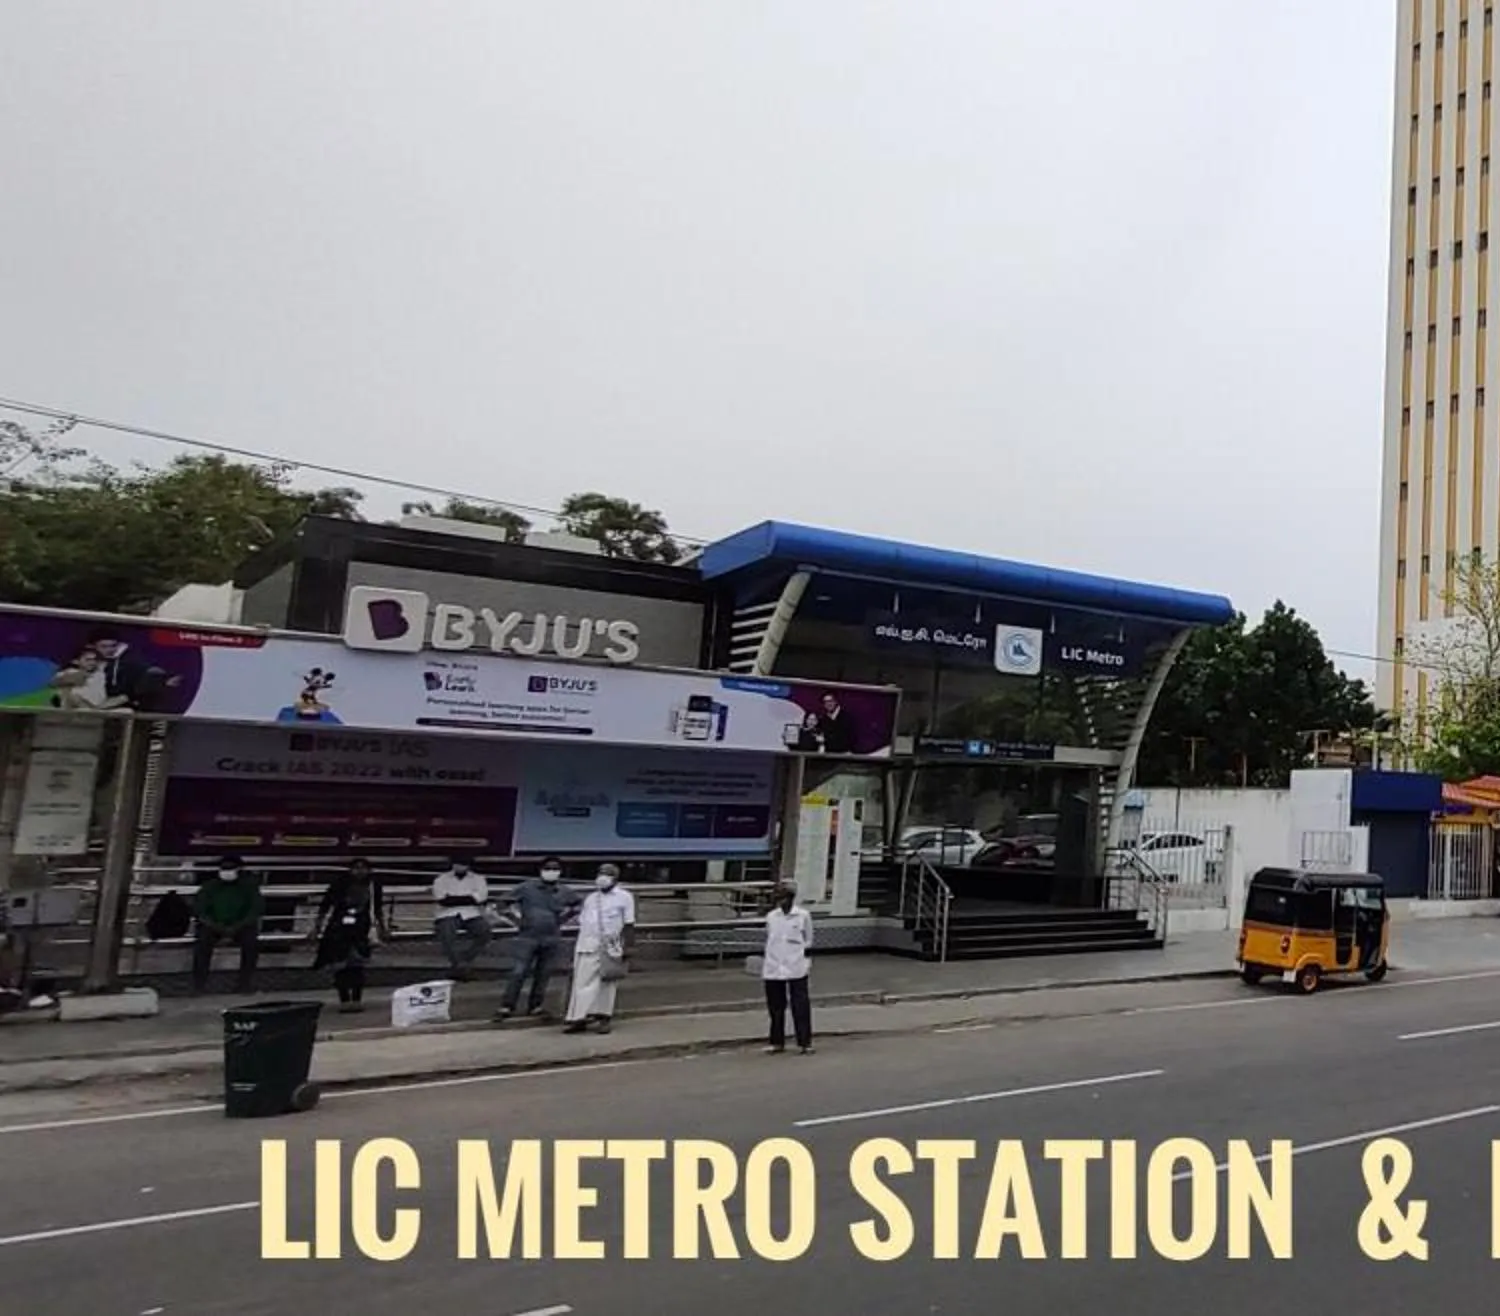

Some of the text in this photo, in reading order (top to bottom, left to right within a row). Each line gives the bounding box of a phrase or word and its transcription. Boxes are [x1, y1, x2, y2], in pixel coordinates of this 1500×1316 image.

[431, 603, 639, 663] BYJU'S
[1061, 646, 1124, 666] LIC Metro
